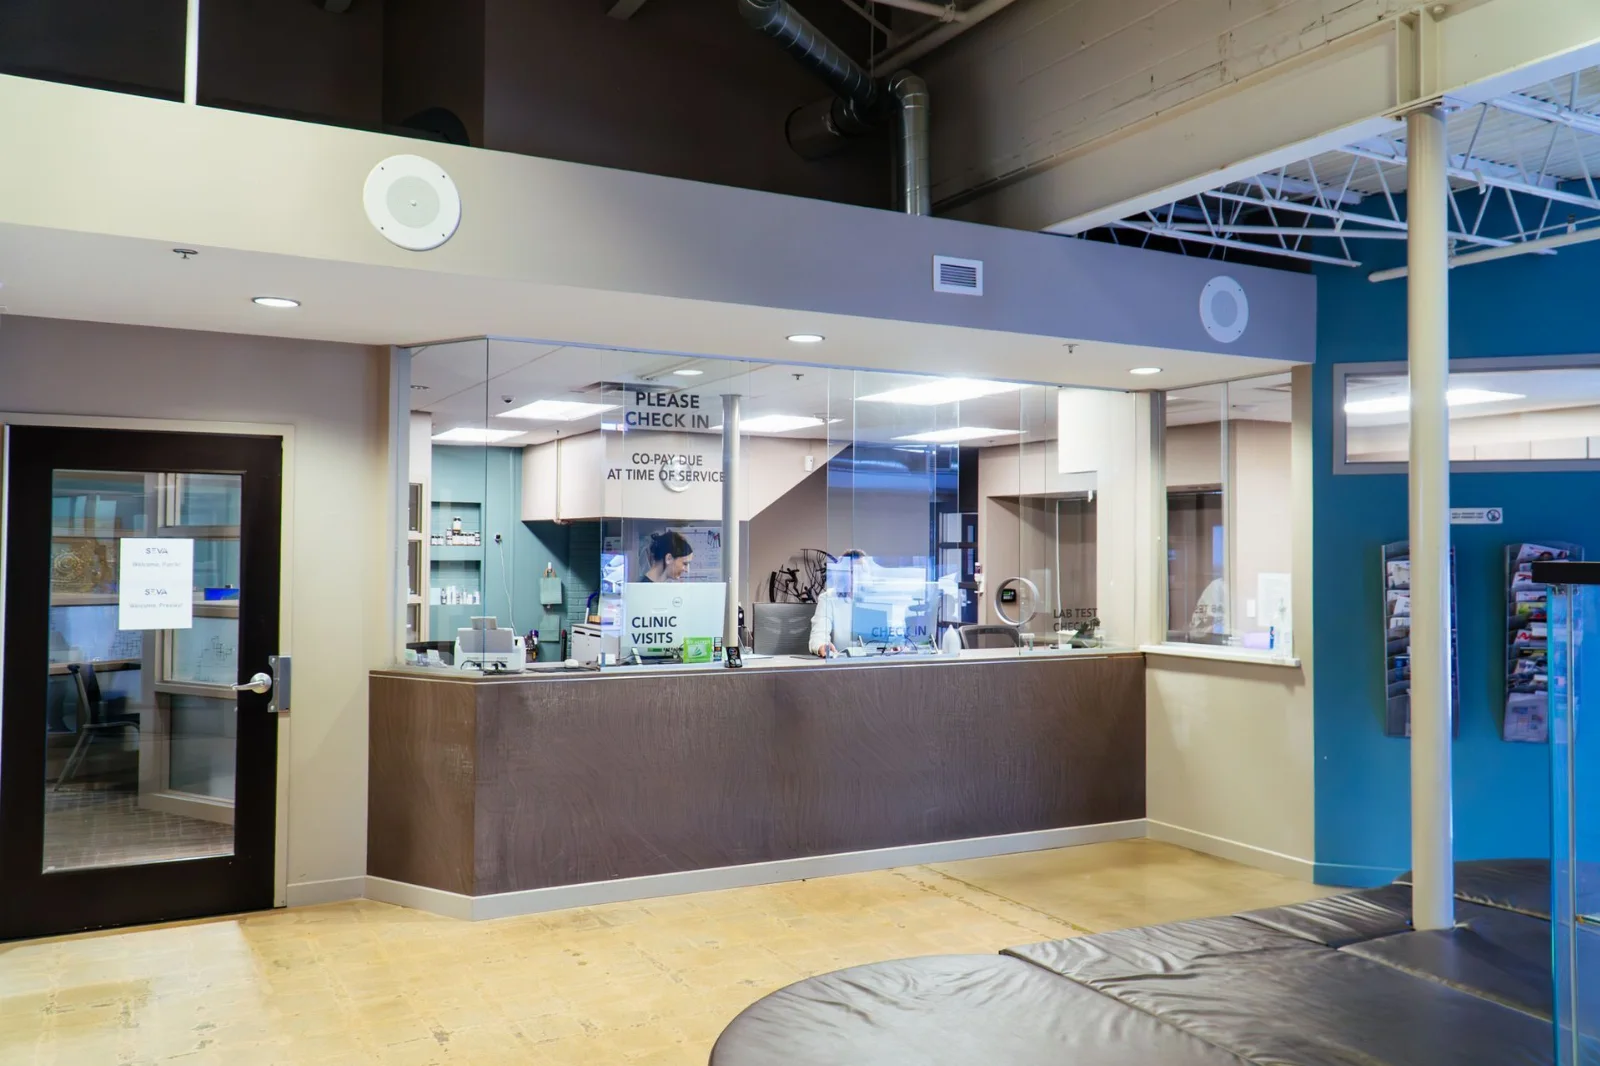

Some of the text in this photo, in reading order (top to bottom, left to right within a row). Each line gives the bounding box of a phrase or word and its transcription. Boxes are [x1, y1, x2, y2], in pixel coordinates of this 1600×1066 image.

[635, 391, 700, 409] PLEASE
[625, 411, 709, 429] CHECK IN
[632, 453, 703, 466] CO-PAY DUE
[607, 468, 726, 483] AT TIME OF SERVICE
[1053, 608, 1097, 618] LAB TEST
[631, 616, 677, 628] CLINIC
[914, 625, 927, 637] IN
[631, 632, 673, 645] VISITS
